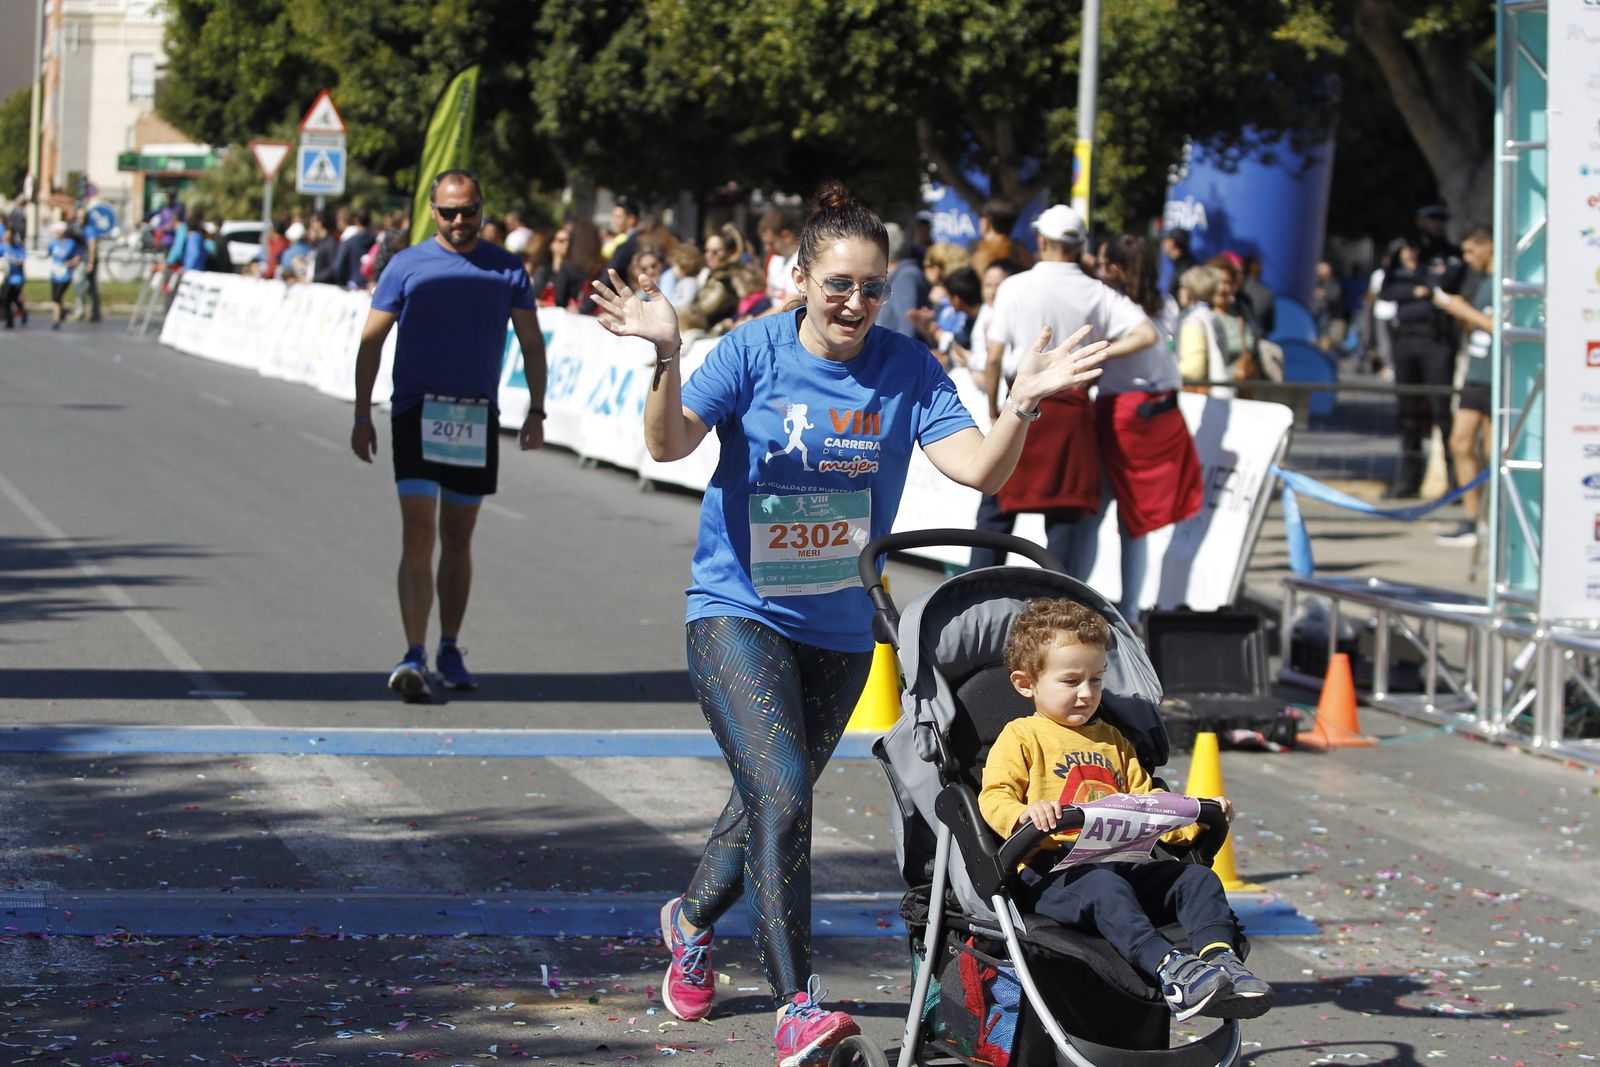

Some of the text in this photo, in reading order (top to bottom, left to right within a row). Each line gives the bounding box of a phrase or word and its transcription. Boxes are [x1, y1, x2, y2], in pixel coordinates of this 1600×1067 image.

[432, 420, 473, 439] 2071
[828, 408, 881, 436] VIII
[824, 437, 881, 451] CARRERA
[768, 482, 807, 492] IGUALDAD
[810, 495, 829, 504] VIII
[768, 520, 850, 549] 2302
[798, 550, 821, 558] MERI
[1053, 751, 1113, 779] NATURE
